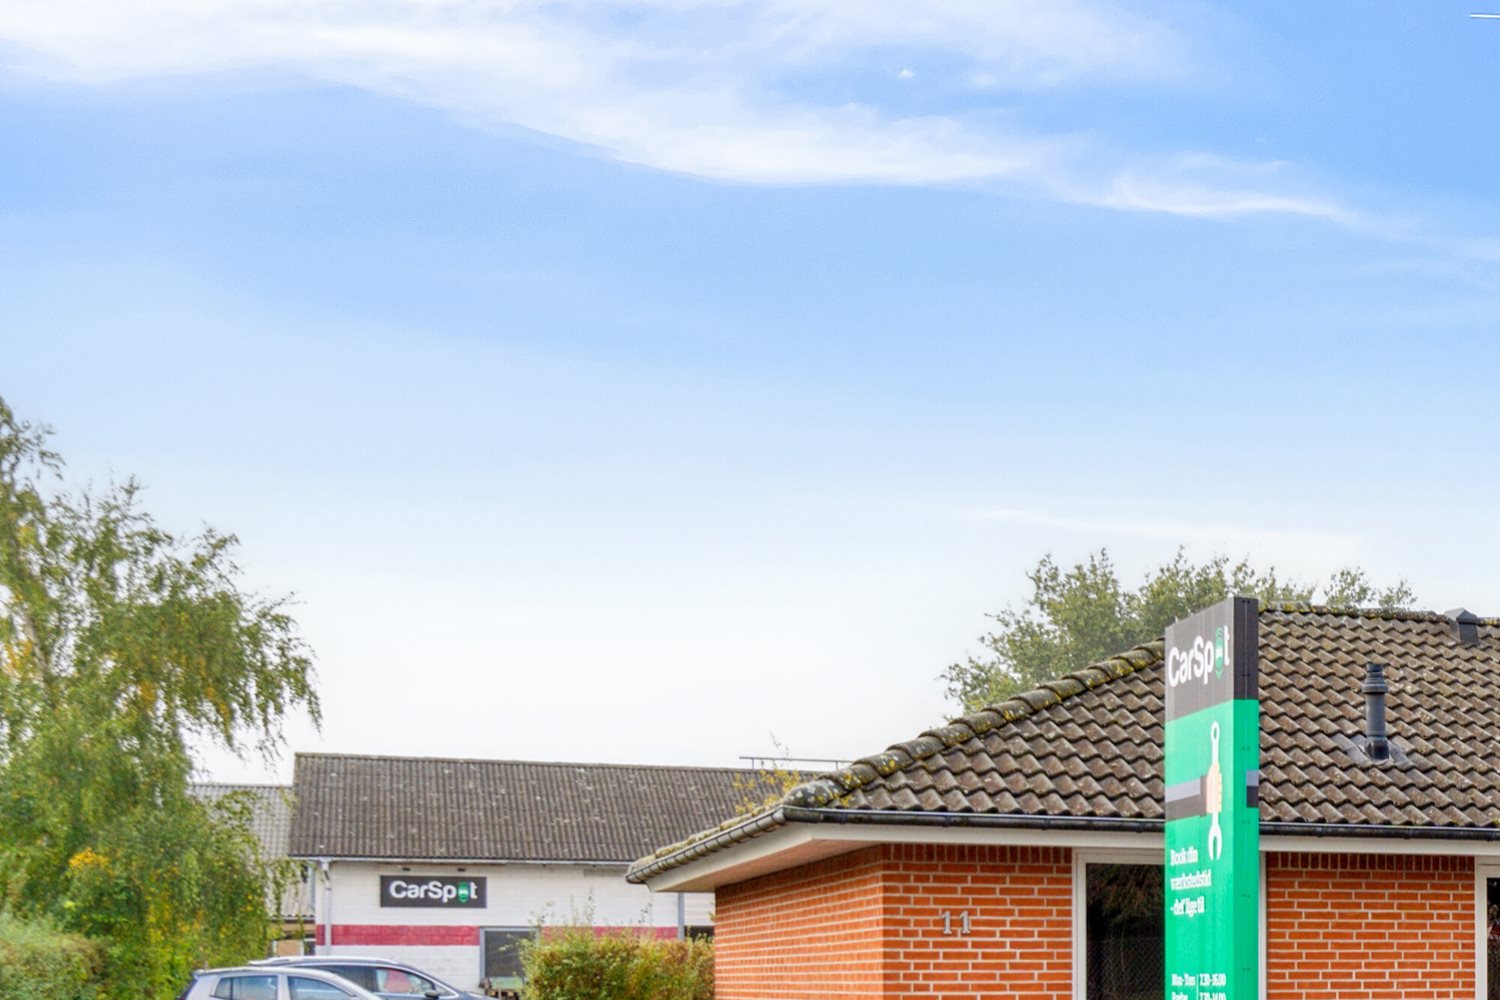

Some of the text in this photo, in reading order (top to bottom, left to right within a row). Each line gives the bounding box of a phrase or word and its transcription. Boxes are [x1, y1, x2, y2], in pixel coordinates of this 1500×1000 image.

[1168, 625, 1230, 687] CarSpot
[390, 880, 478, 903] CarSpot
[941, 911, 971, 935] 11
